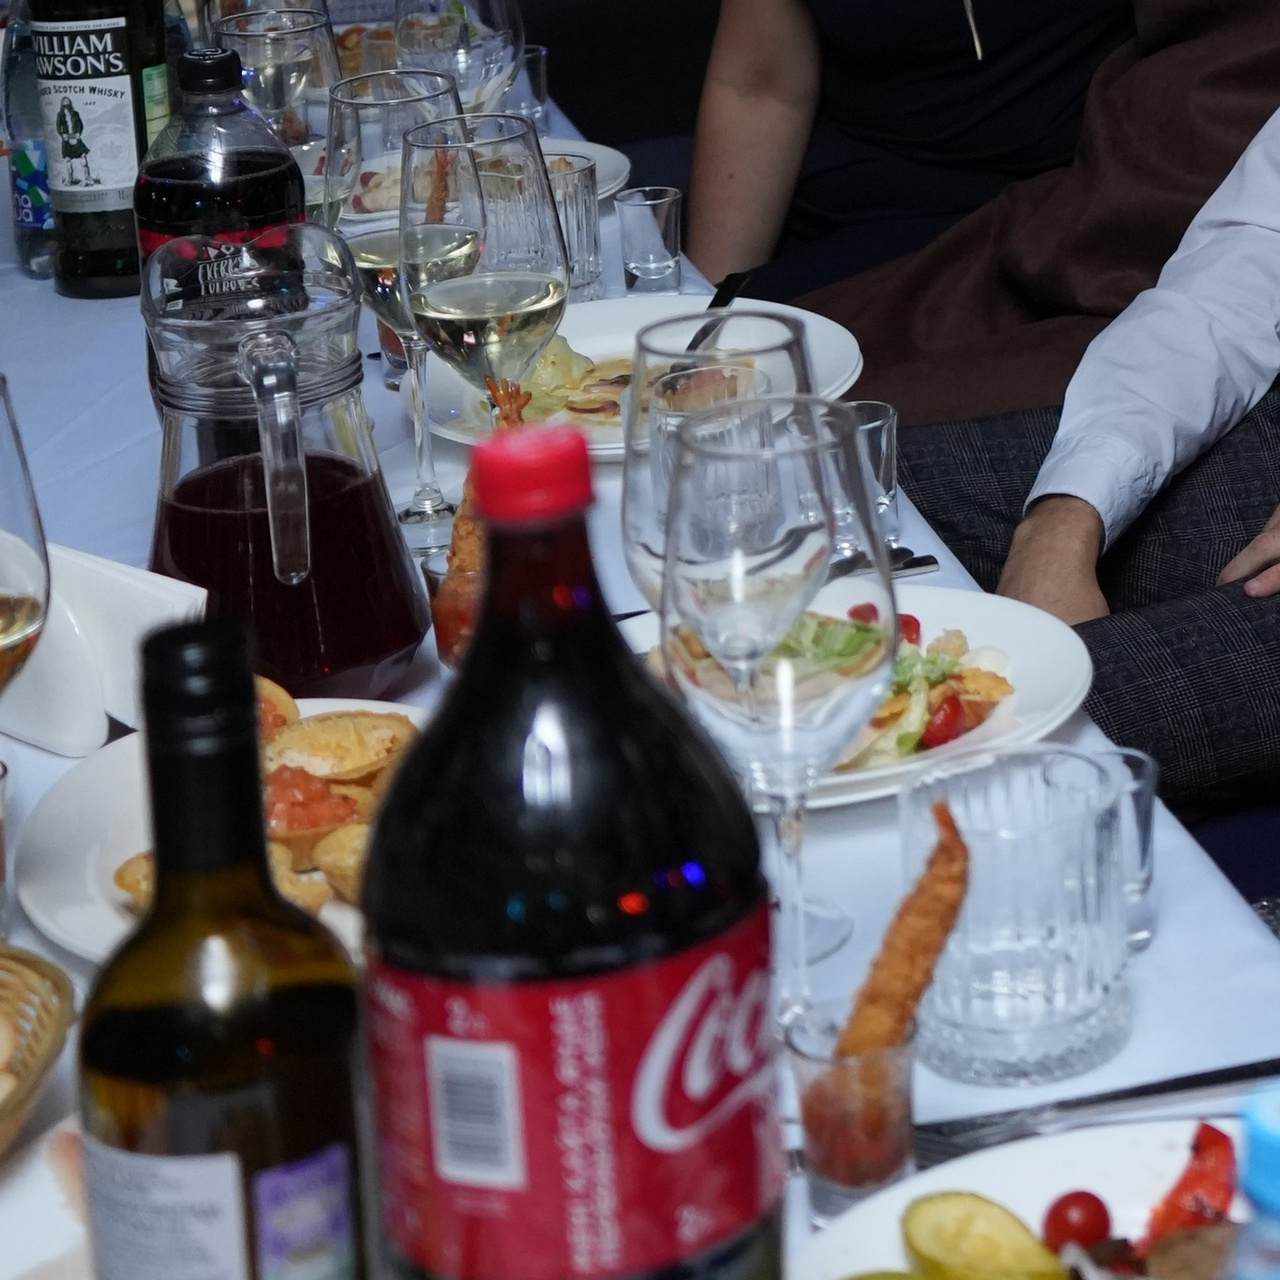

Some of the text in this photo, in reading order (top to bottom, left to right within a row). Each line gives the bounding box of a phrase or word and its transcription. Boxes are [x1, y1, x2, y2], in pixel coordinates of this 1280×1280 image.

[36, 52, 124, 76] AWSON'S
[53, 85, 85, 94] SCOTCH
[88, 85, 126, 99] WHISKY
